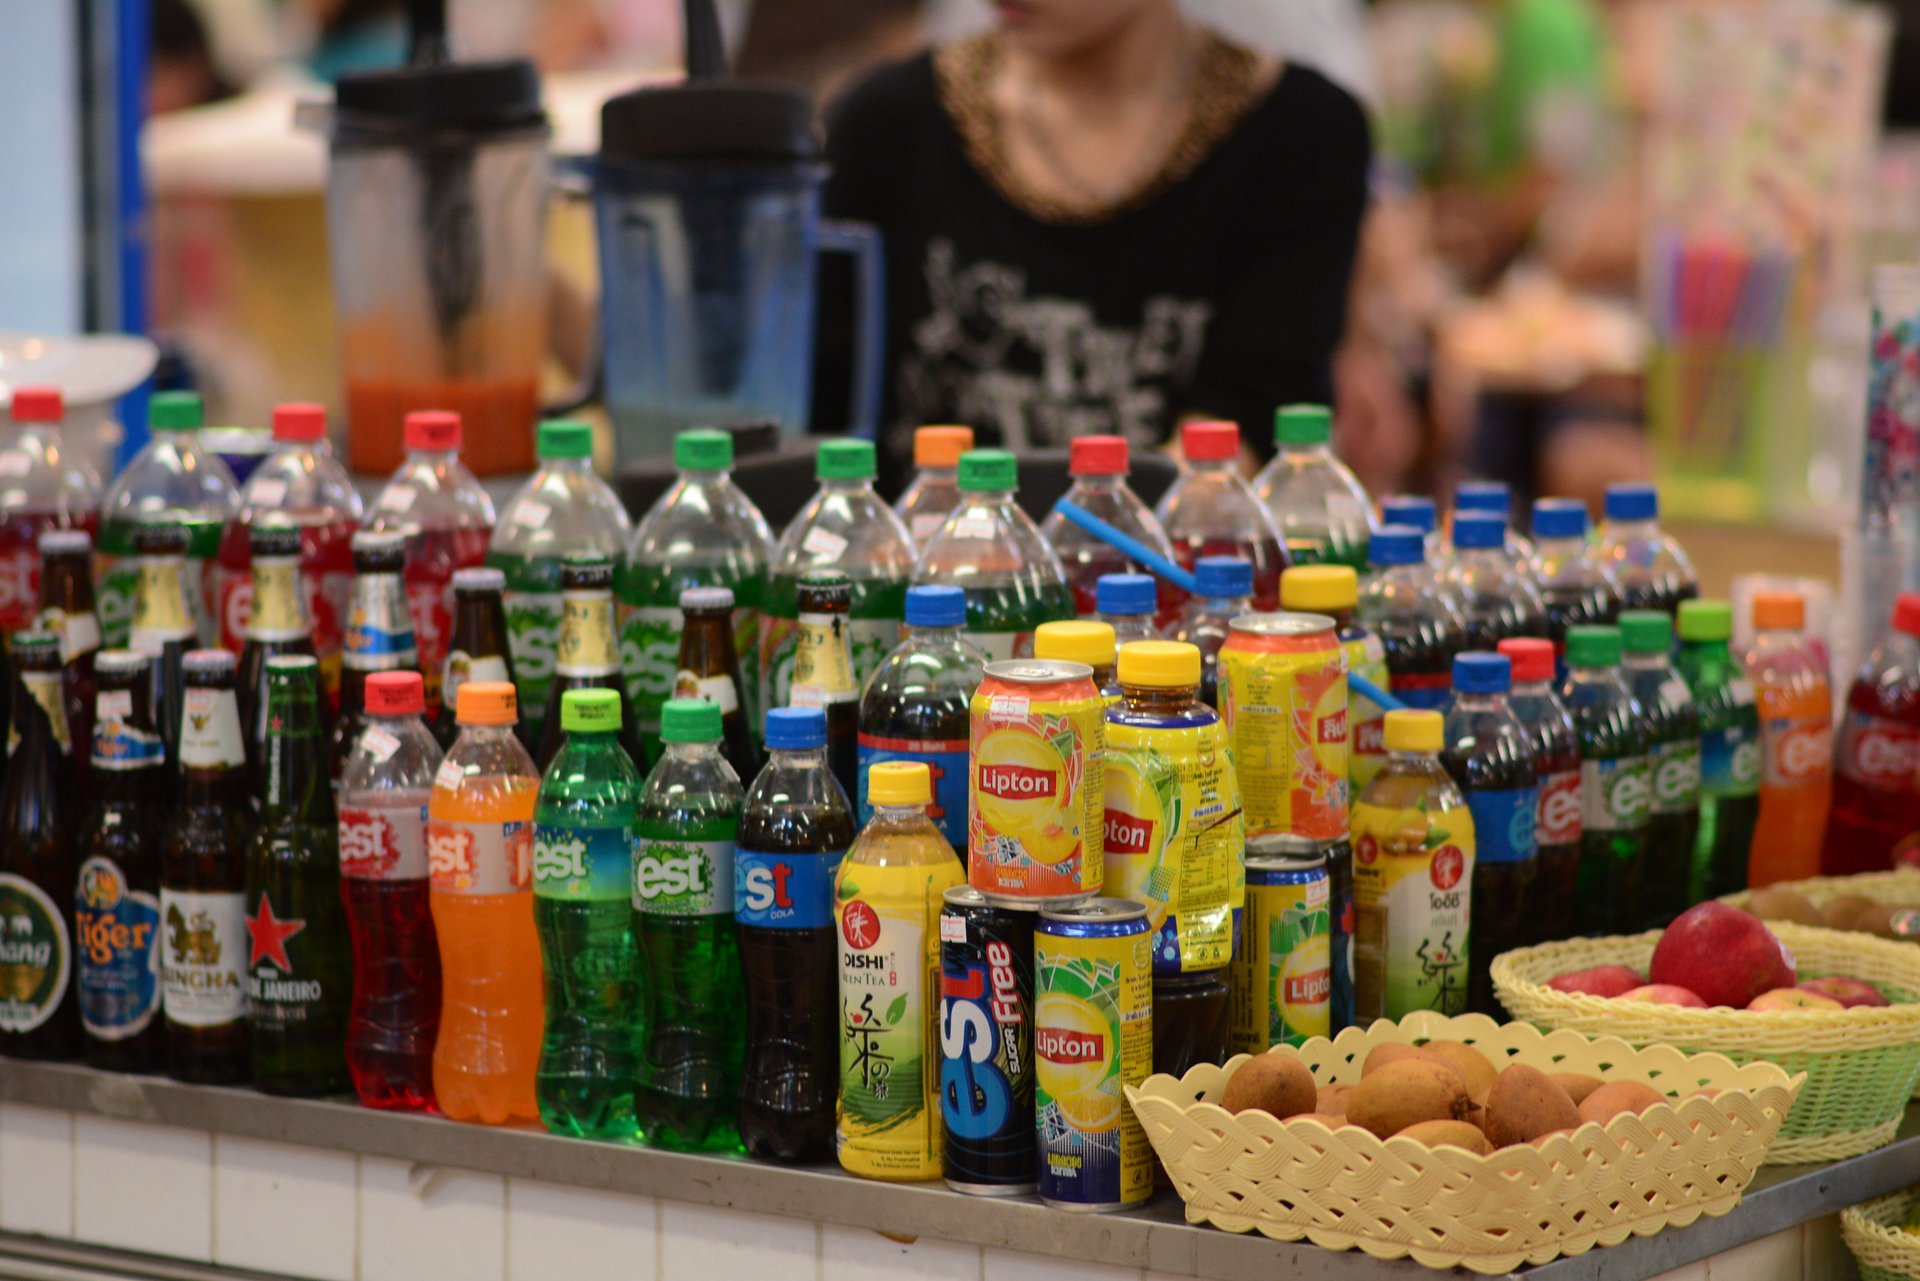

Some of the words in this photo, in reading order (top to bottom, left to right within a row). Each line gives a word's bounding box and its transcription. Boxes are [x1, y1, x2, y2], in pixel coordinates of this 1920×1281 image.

[982, 768, 1049, 795] Lipton
[535, 839, 587, 881] est
[638, 853, 706, 899] est
[770, 908, 795, 920] COLA
[845, 952, 884, 970] OISHI
[263, 980, 322, 1001] JANEIRO
[988, 941, 1022, 1023] Free
[1004, 1027, 1020, 1073] SUGAR
[1037, 1029, 1096, 1058] Lipton
